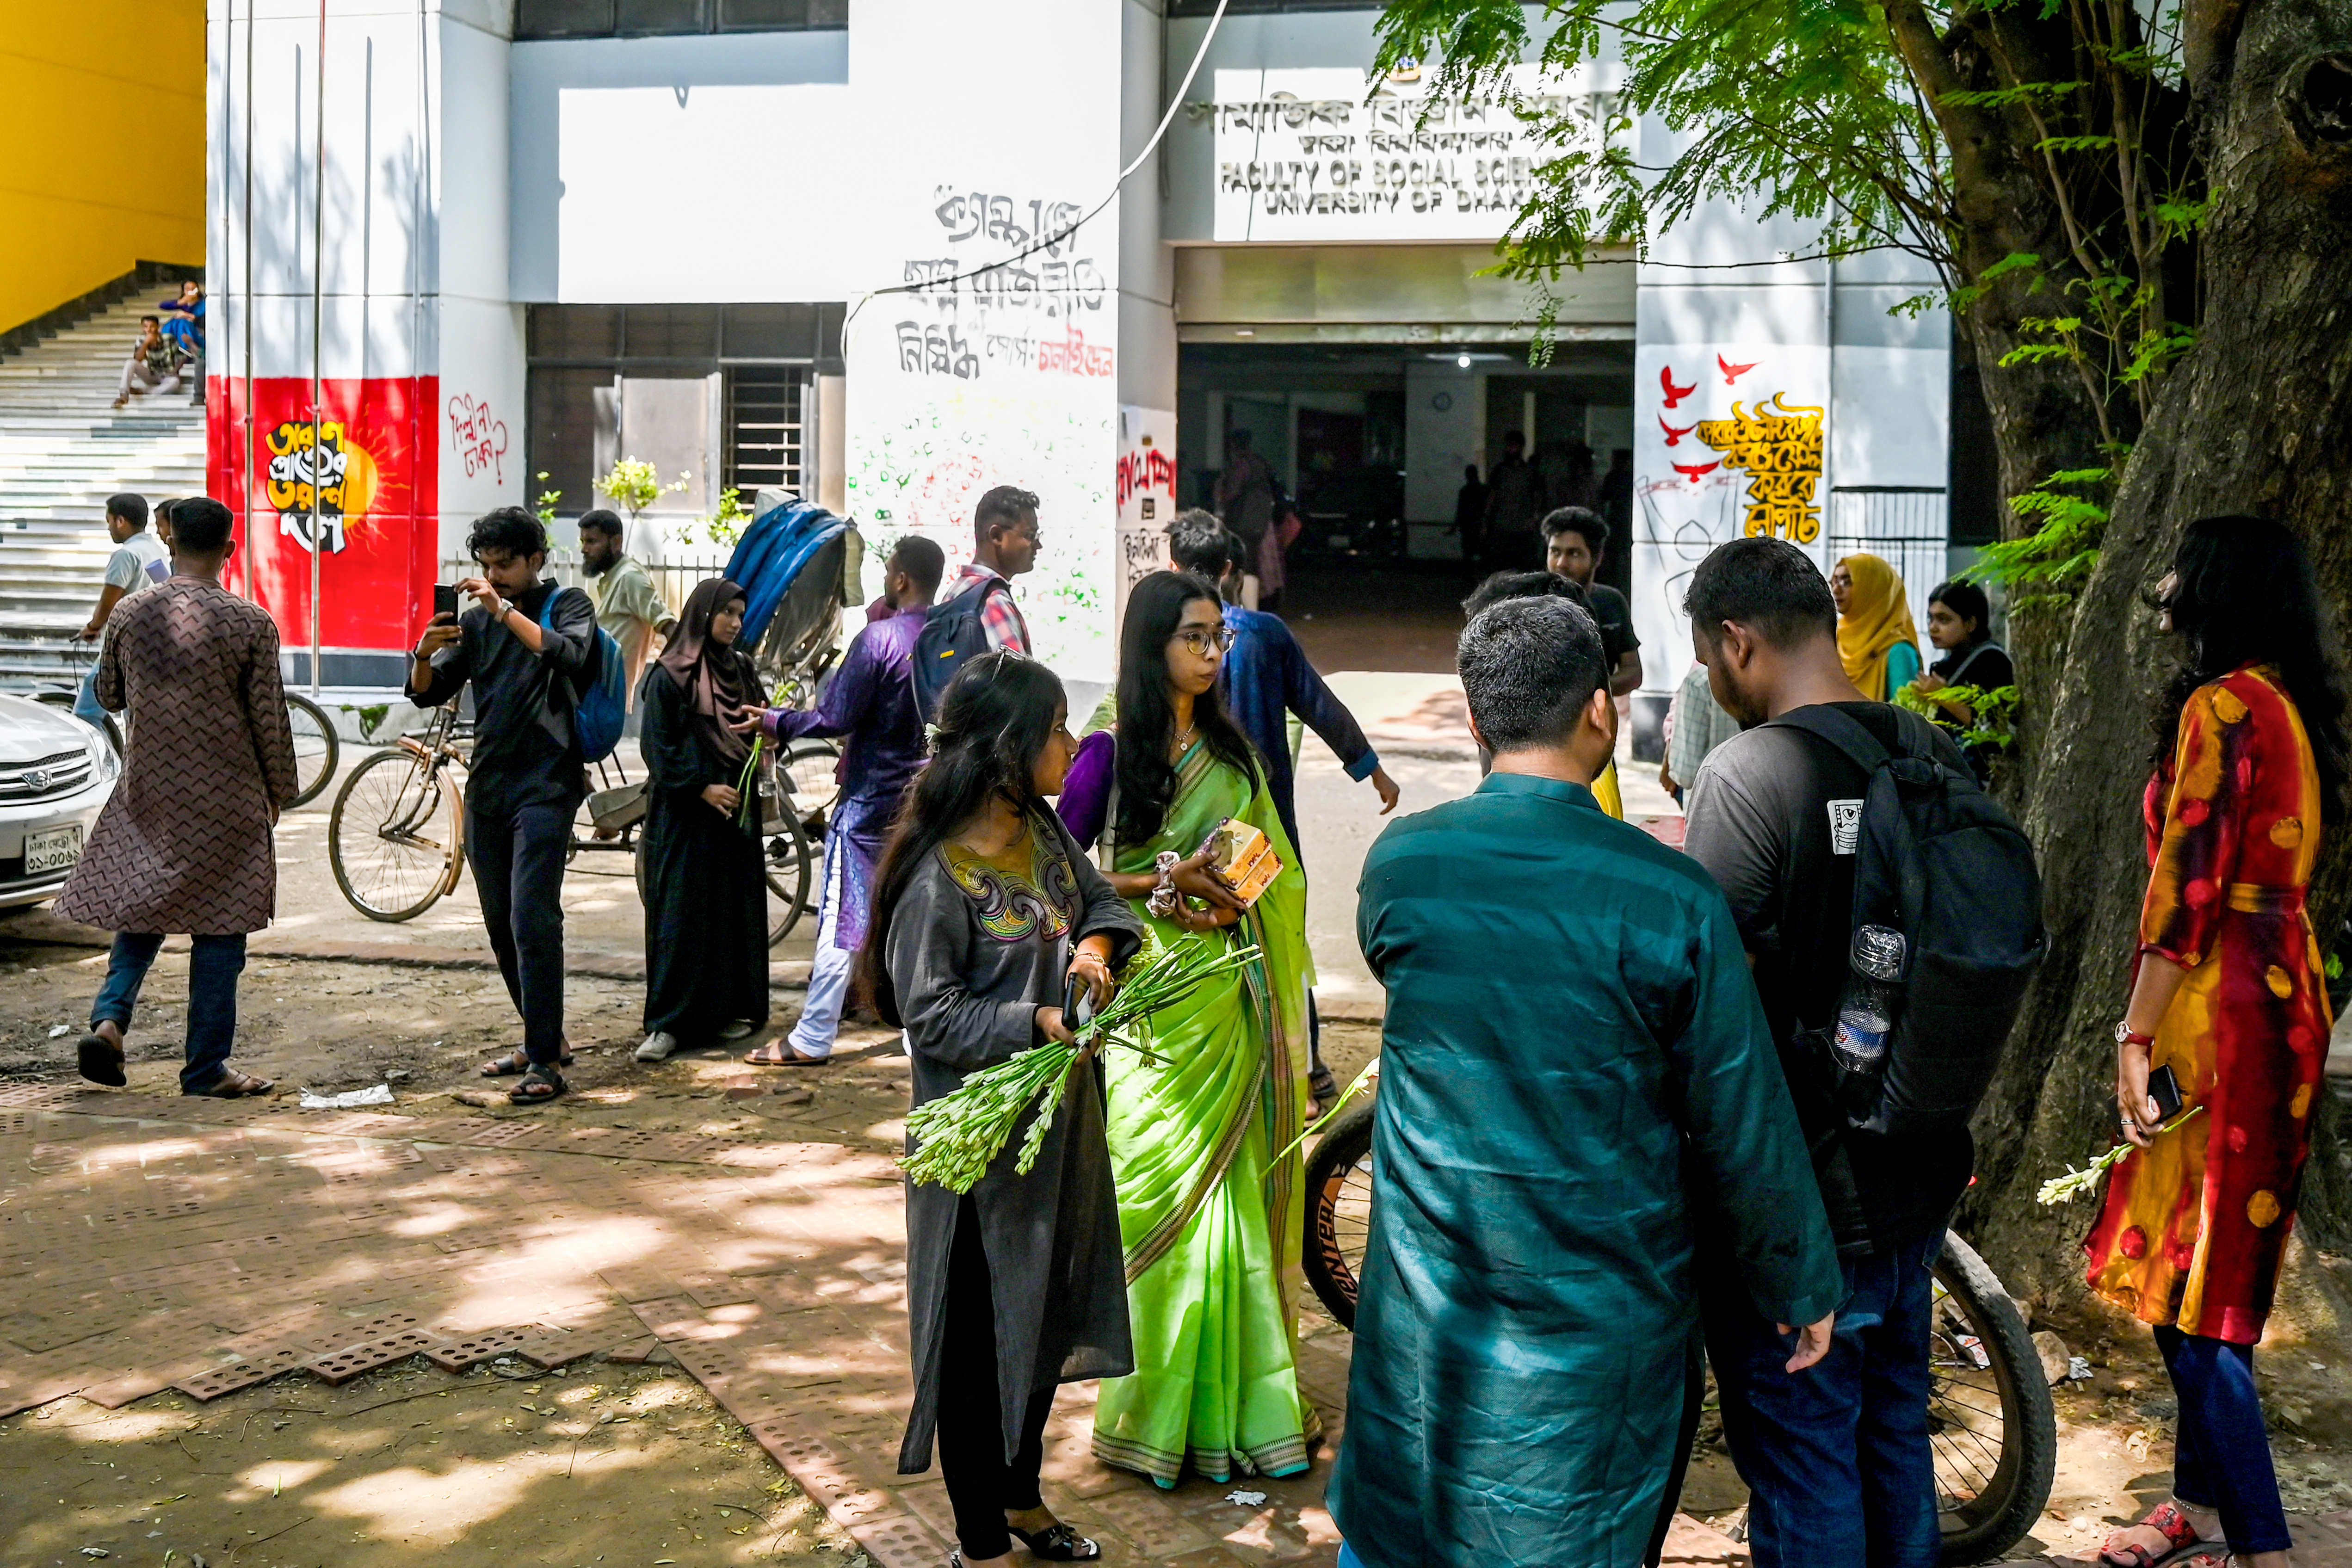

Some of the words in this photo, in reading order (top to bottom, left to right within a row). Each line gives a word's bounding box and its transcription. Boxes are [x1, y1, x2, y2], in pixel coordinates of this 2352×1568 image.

[1370, 89, 1492, 130] বিজ্ঞান
[1298, 135, 1355, 155] ঢাকা
[1220, 160, 1319, 193] FACULTY
[1330, 159, 1361, 189] OF
[1372, 159, 1463, 190] SOCIAL
[1265, 191, 1400, 216] UNIVERSITY
[1410, 191, 1442, 213] OF
[1457, 189, 1538, 213] DHAK
